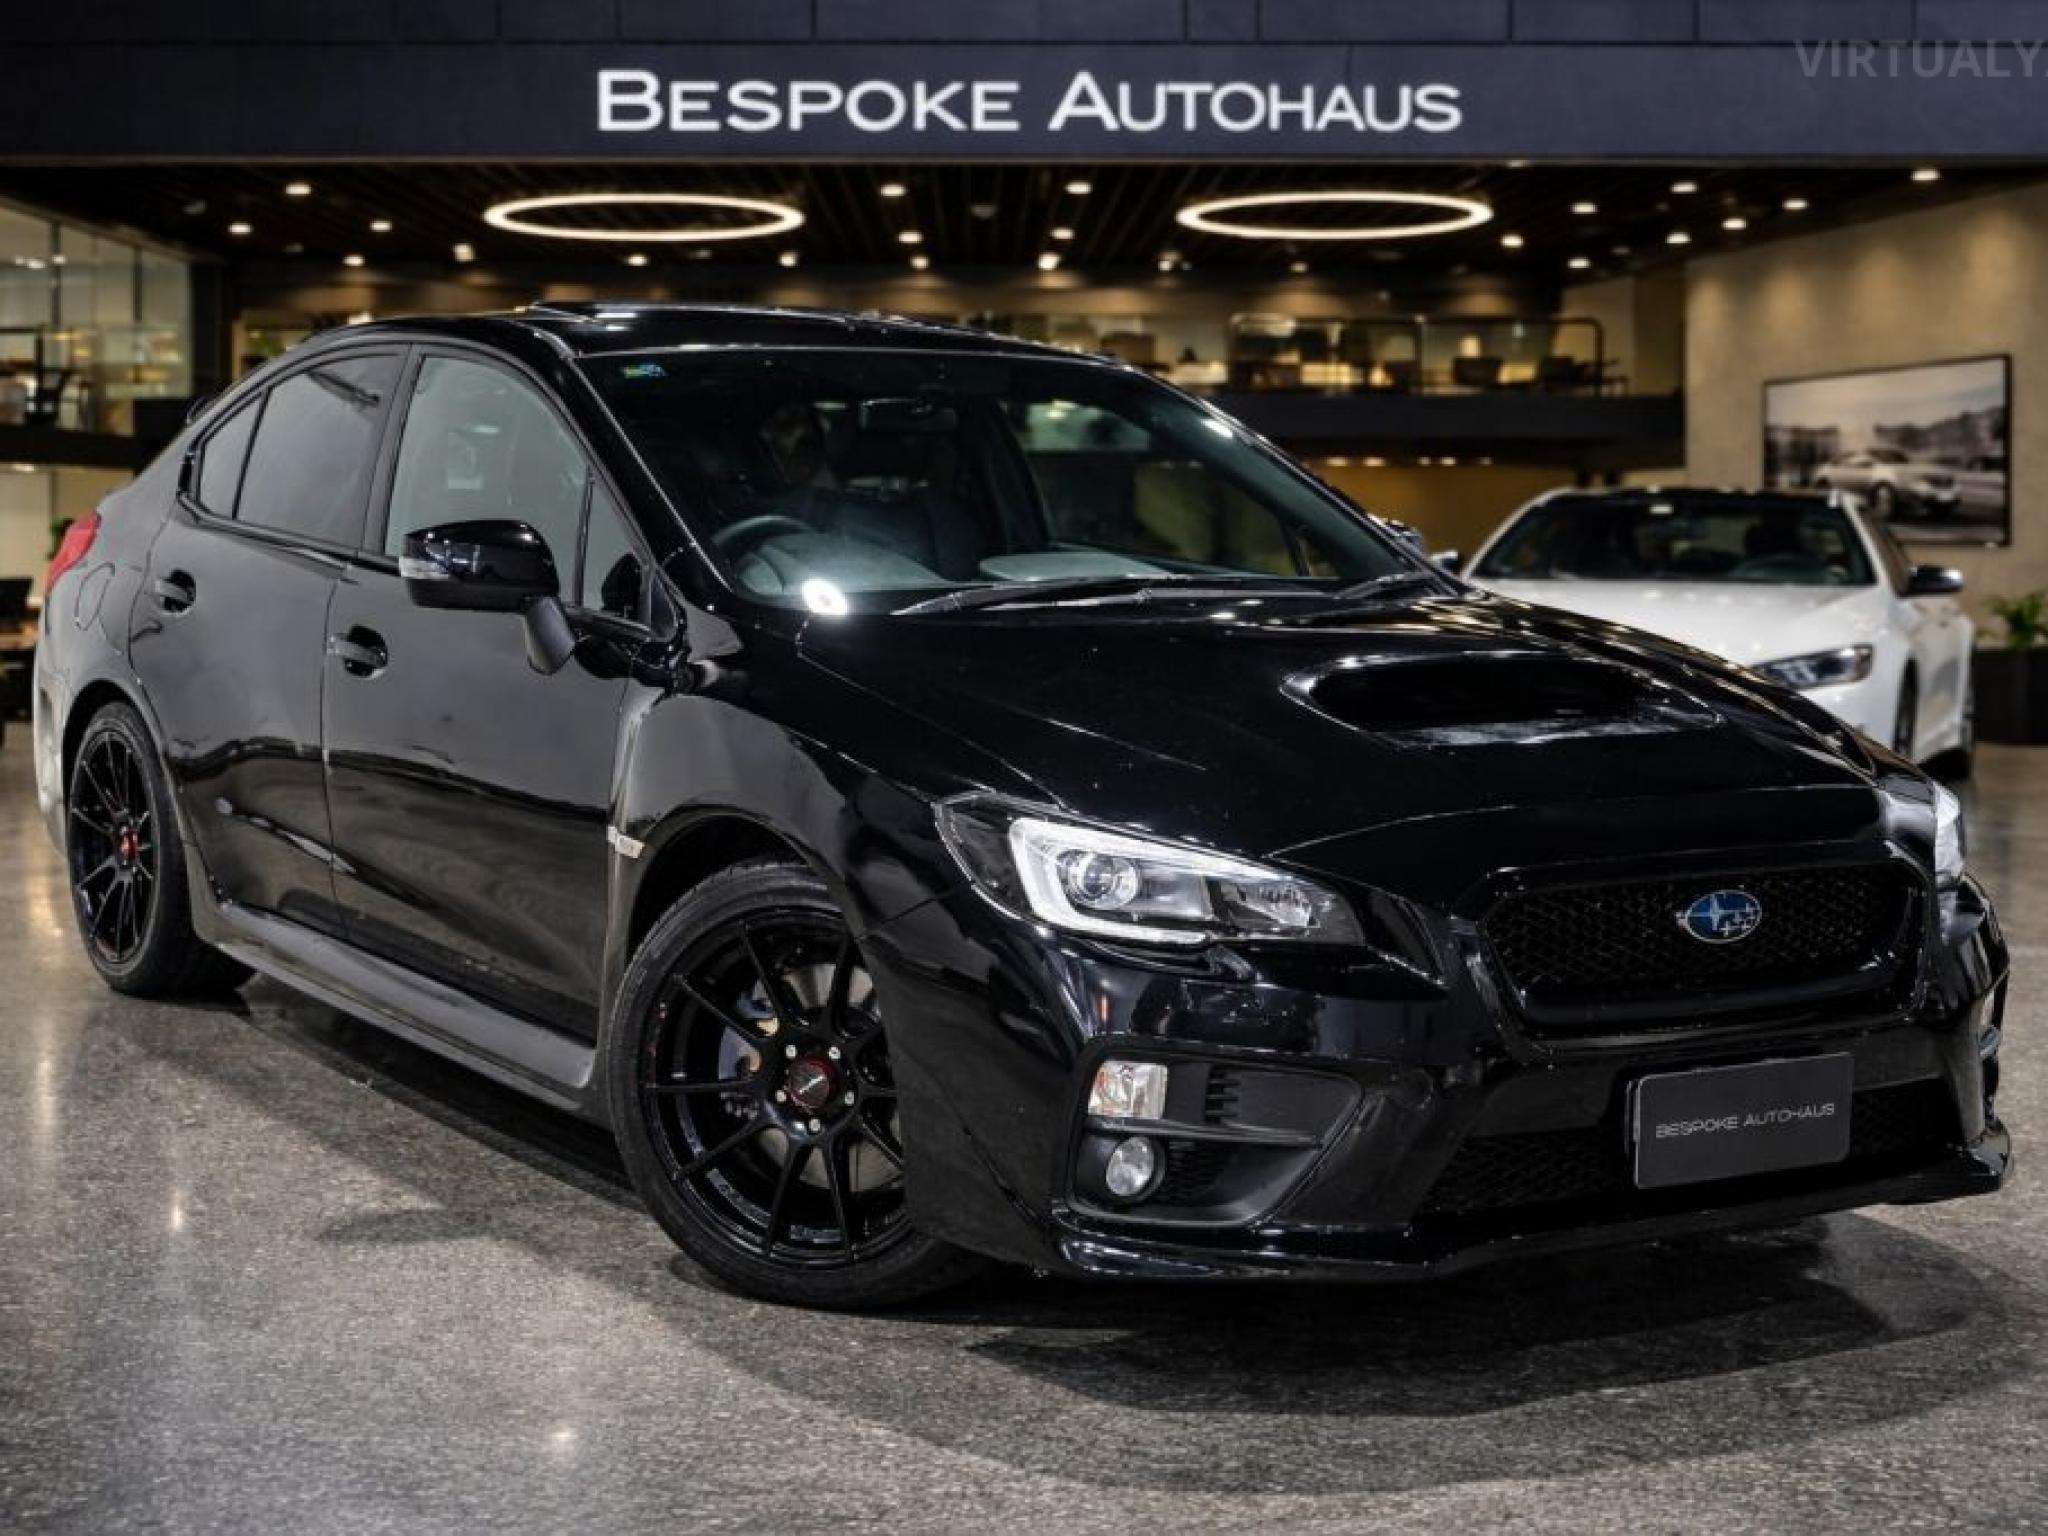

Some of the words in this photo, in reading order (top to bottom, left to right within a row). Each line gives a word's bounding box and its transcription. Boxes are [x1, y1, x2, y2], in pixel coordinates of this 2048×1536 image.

[597, 70, 1020, 131] BESPOKE
[1048, 71, 1463, 132] AUTOHAUS
[1655, 1115, 1738, 1138] BESPOKE
[1743, 1103, 1836, 1127] AUTOHAUS
